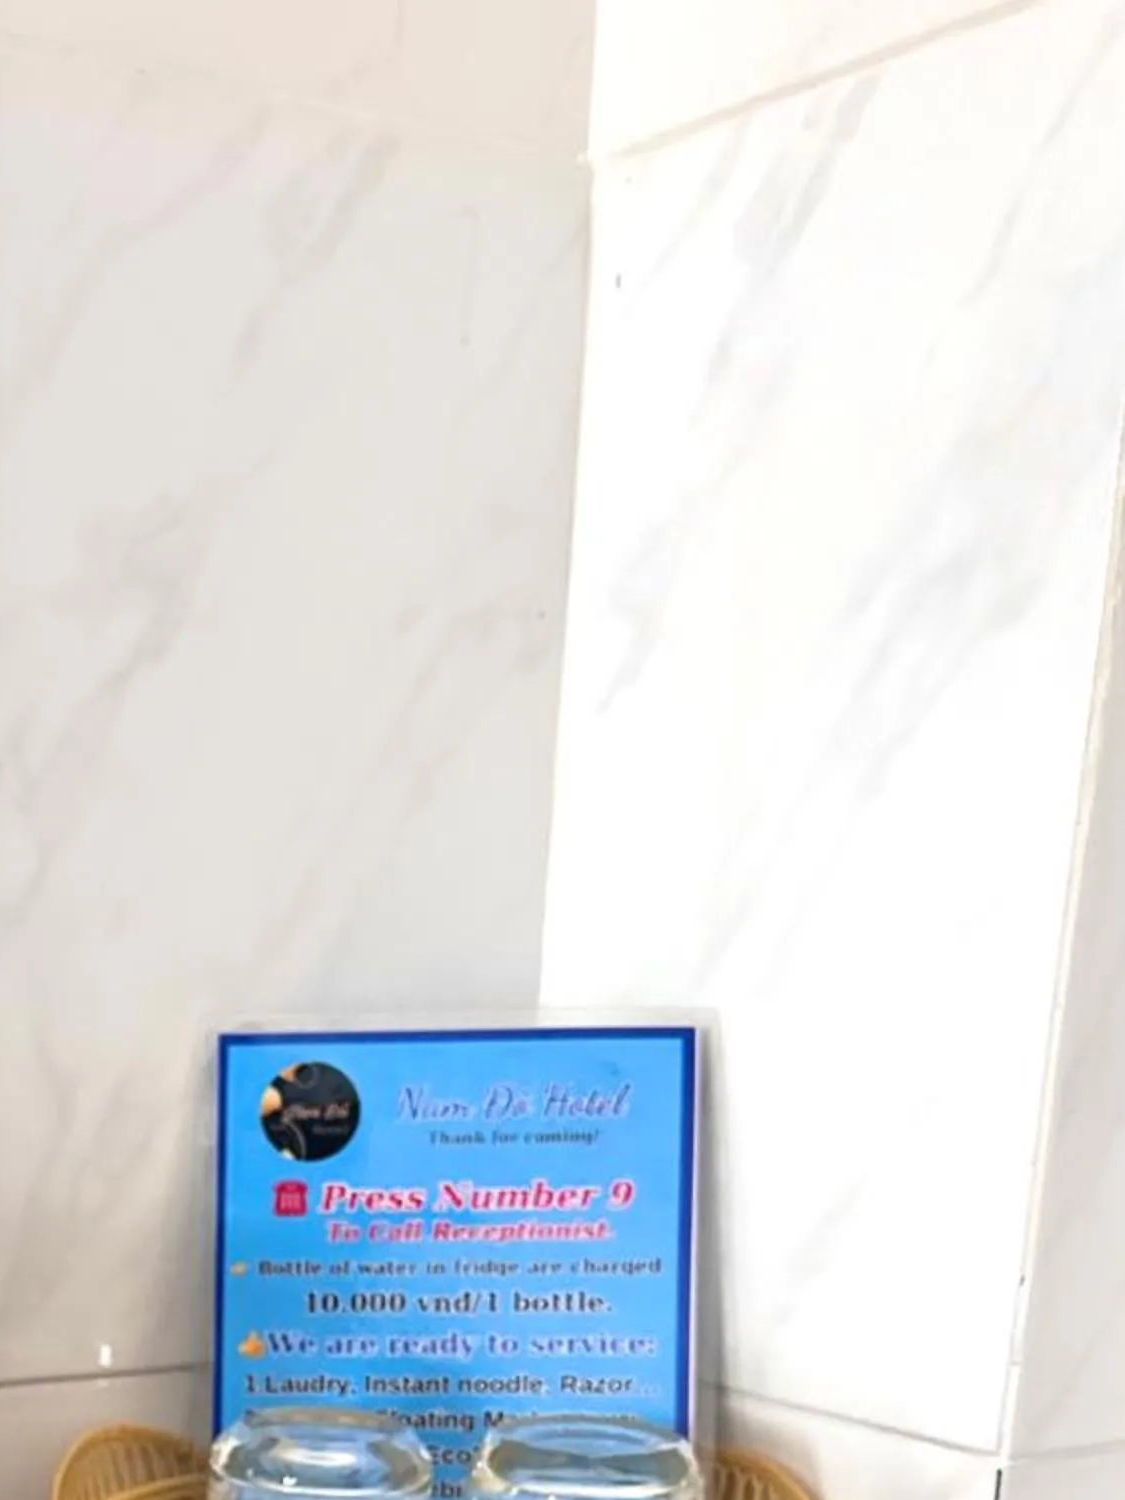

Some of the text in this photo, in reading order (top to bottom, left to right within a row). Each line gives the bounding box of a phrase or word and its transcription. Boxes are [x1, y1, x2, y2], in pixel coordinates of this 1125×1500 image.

[401, 1086, 470, 1120] Nam
[542, 1083, 632, 1118] Hotel
[429, 1131, 485, 1145] Thank
[491, 1130, 518, 1146] for
[321, 1180, 634, 1213] Press Number 9
[328, 1221, 362, 1242] To
[369, 1221, 424, 1244] Call
[258, 1256, 663, 1277] Bottle of water in fridge are charged
[417, 1289, 499, 1314] vnd/1
[513, 1289, 614, 1313] bottle.
[268, 1331, 656, 1357] We are ready to service:
[365, 1375, 450, 1394] Instant
